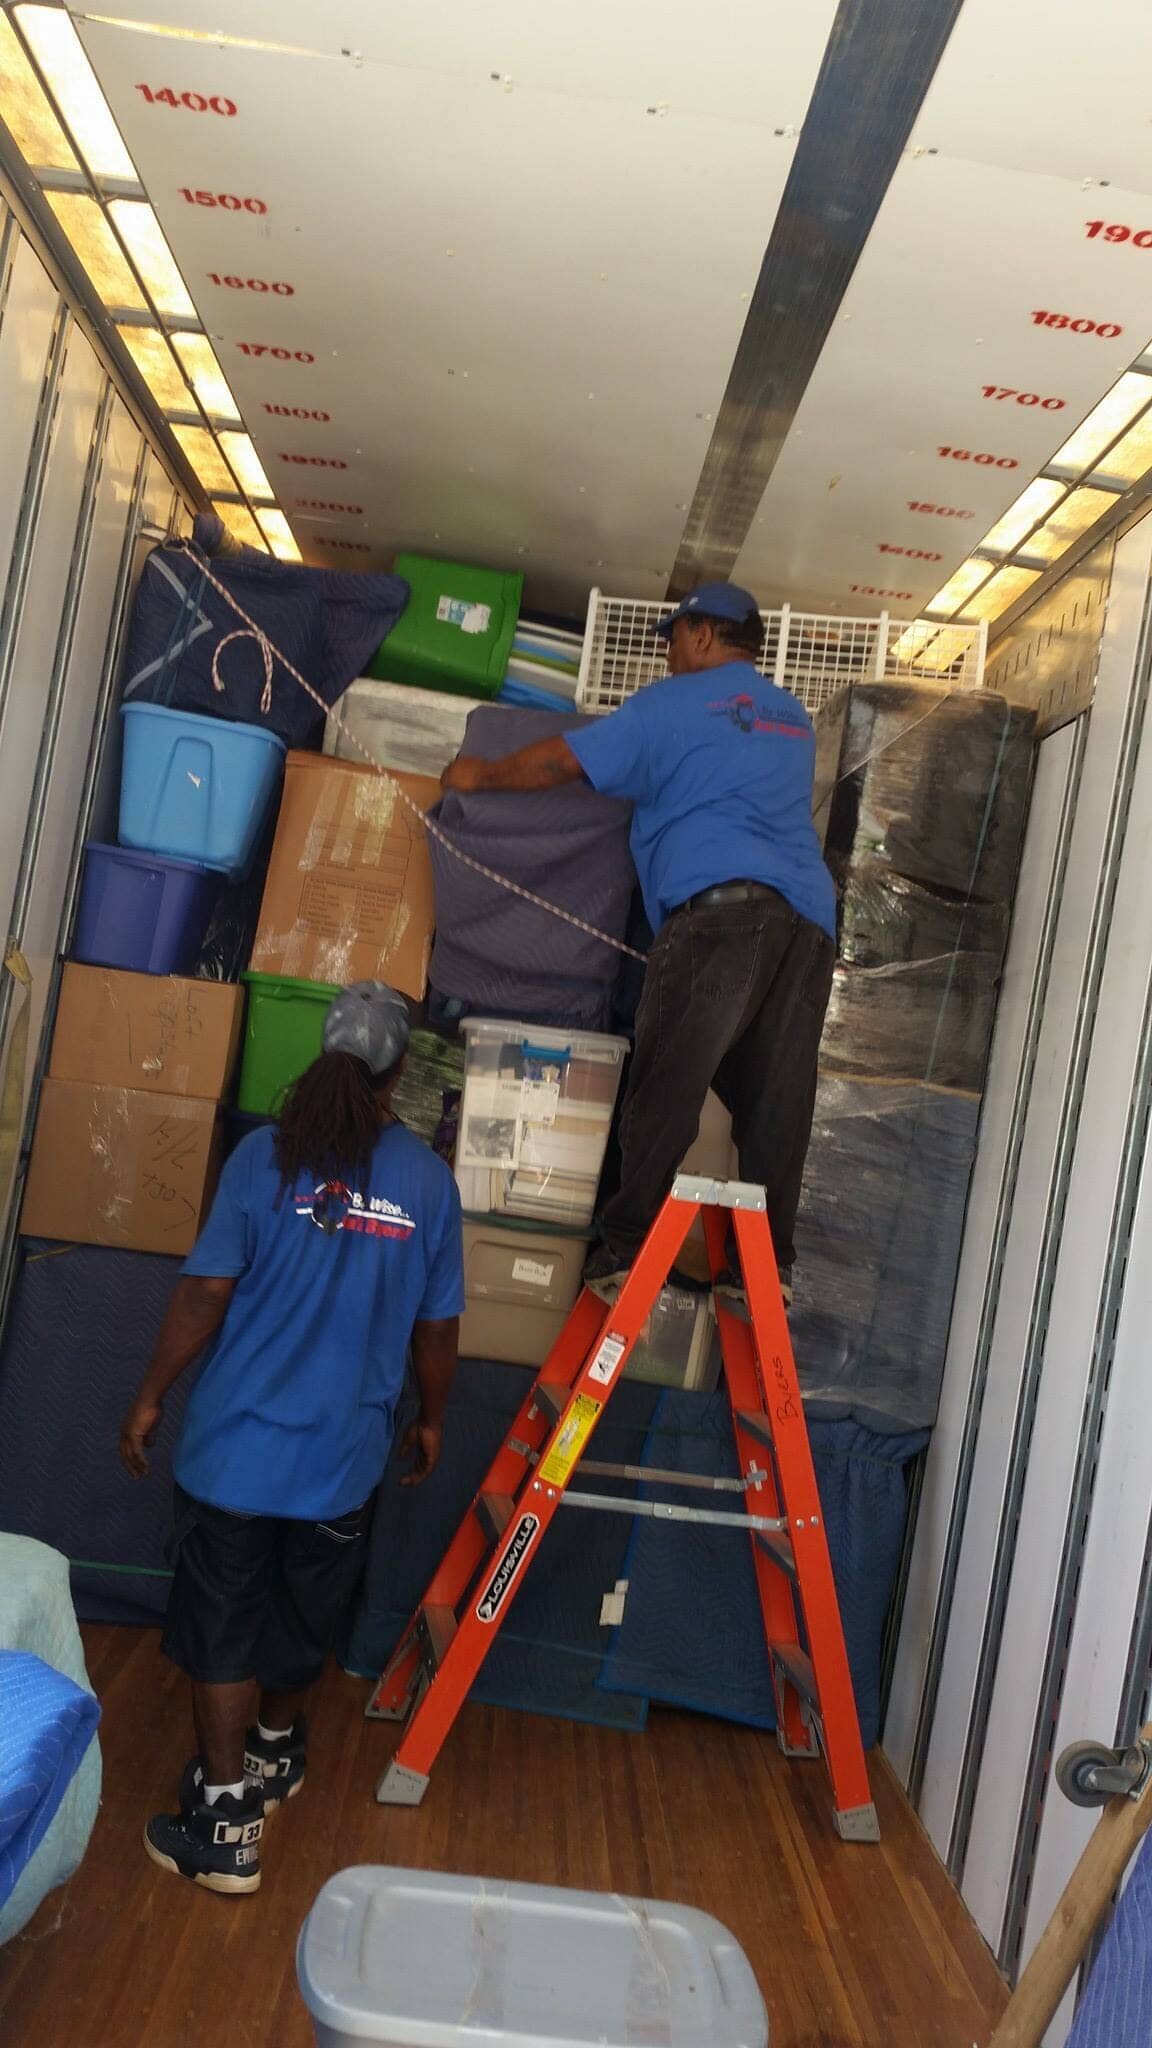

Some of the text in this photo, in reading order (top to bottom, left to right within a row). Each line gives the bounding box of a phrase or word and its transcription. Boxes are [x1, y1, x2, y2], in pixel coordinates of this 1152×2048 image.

[135, 83, 237, 117] 1400
[178, 188, 267, 215] 1500
[207, 272, 295, 296] 1600
[1031, 309, 1123, 338] 1800
[236, 342, 315, 364] 1700
[981, 385, 1066, 410] 1700
[262, 402, 331, 423] 1800
[279, 452, 347, 470] 1900
[938, 446, 1018, 469] 1600
[907, 501, 975, 519] 1500
[878, 543, 943, 562] 1400
[488, 1516, 535, 1603] LOUISVILLE
[245, 1758, 260, 1772] 33
[247, 1823, 260, 1840] 33
